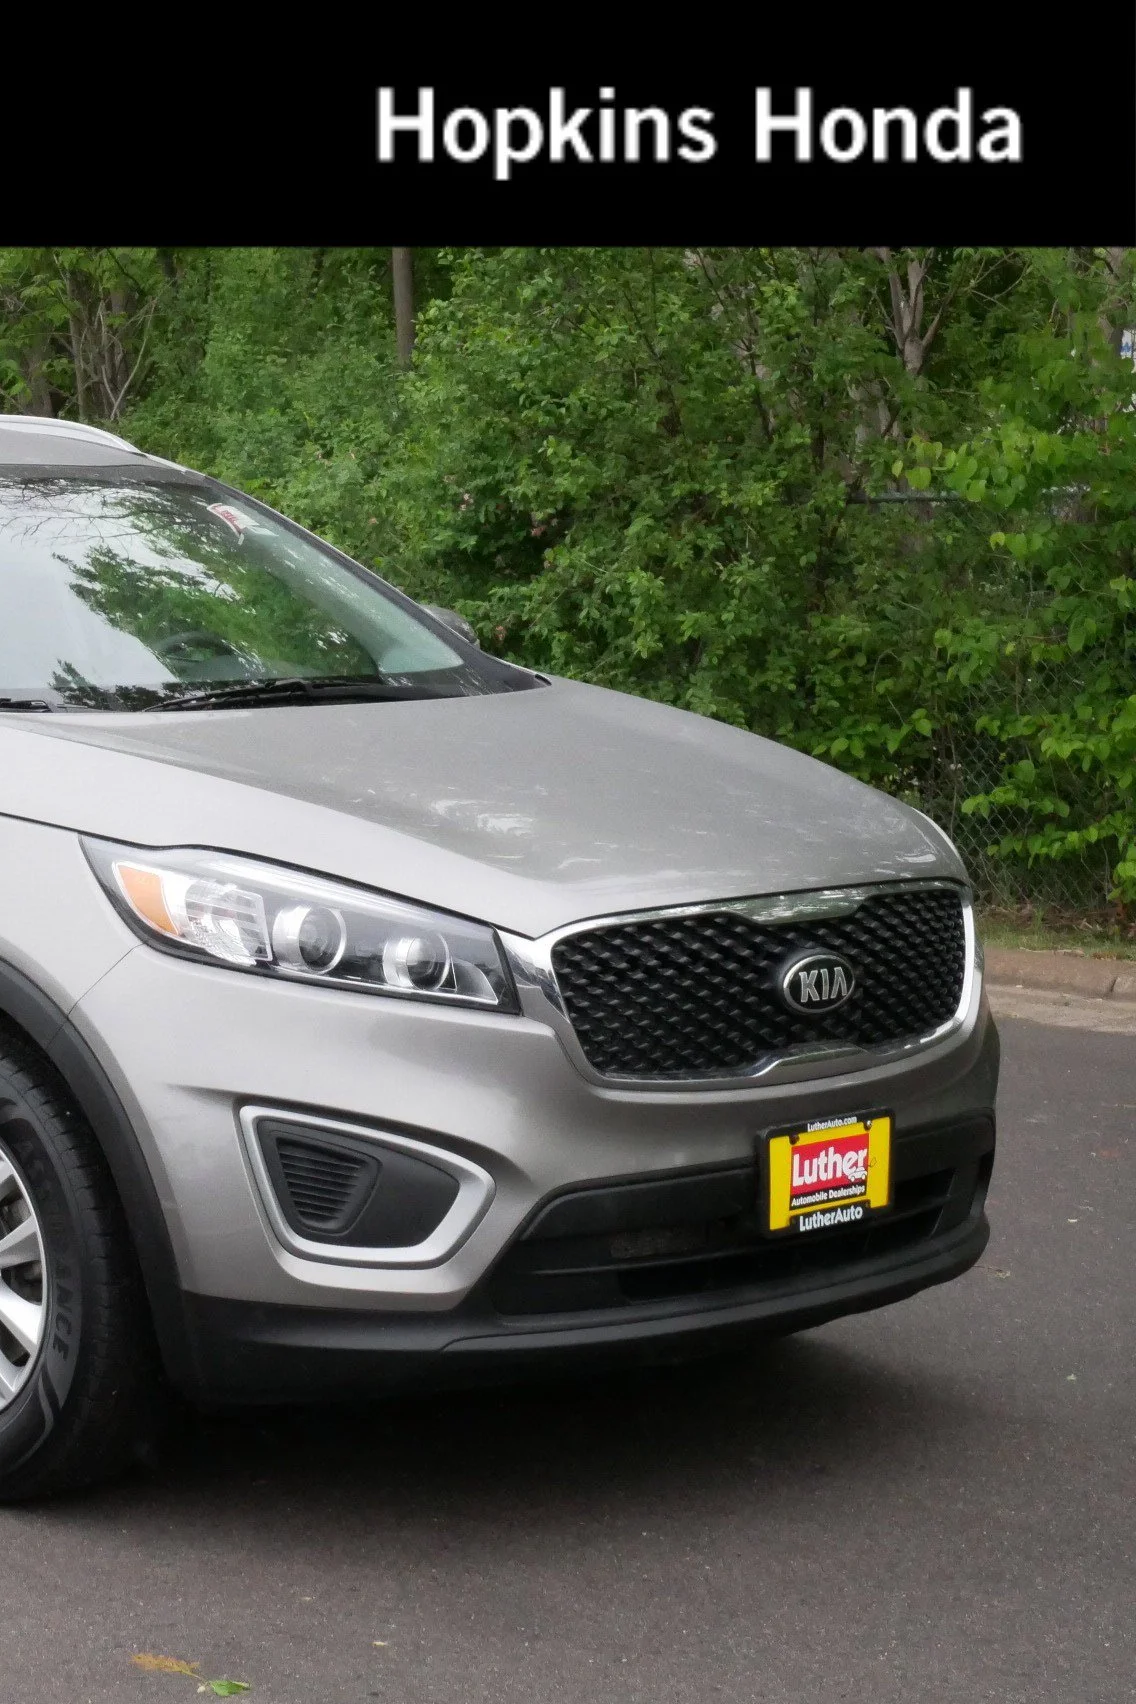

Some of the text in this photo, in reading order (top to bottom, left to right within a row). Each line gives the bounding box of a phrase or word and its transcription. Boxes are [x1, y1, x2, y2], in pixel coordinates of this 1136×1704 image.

[798, 966, 848, 1003] KIA
[807, 1116, 857, 1132] LutherAuto.com
[792, 1146, 868, 1187] Luther
[791, 1184, 865, 1207] Automobile Dealerships
[799, 1205, 863, 1232] LutherAuto
